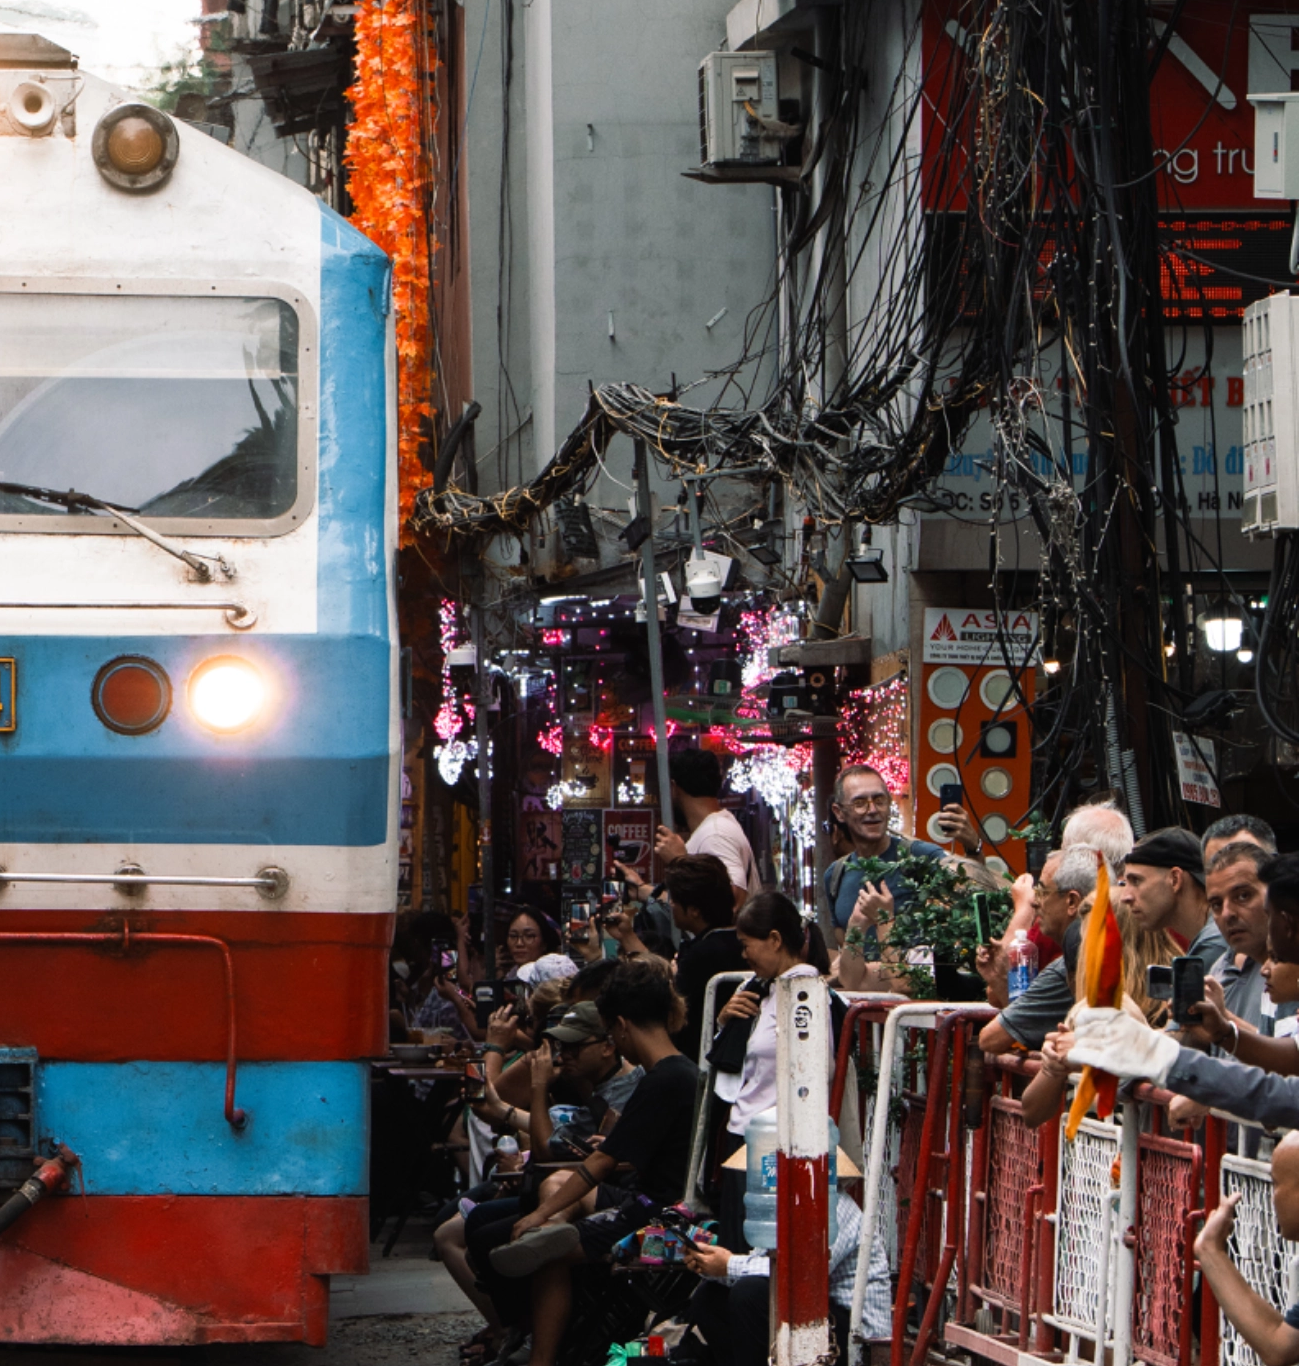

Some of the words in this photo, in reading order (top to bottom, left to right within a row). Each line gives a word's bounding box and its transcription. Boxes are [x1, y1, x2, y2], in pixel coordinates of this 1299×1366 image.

[960, 613, 1032, 631] ASIA
[930, 643, 954, 651] YOUR
[607, 823, 649, 839] COFFEE
